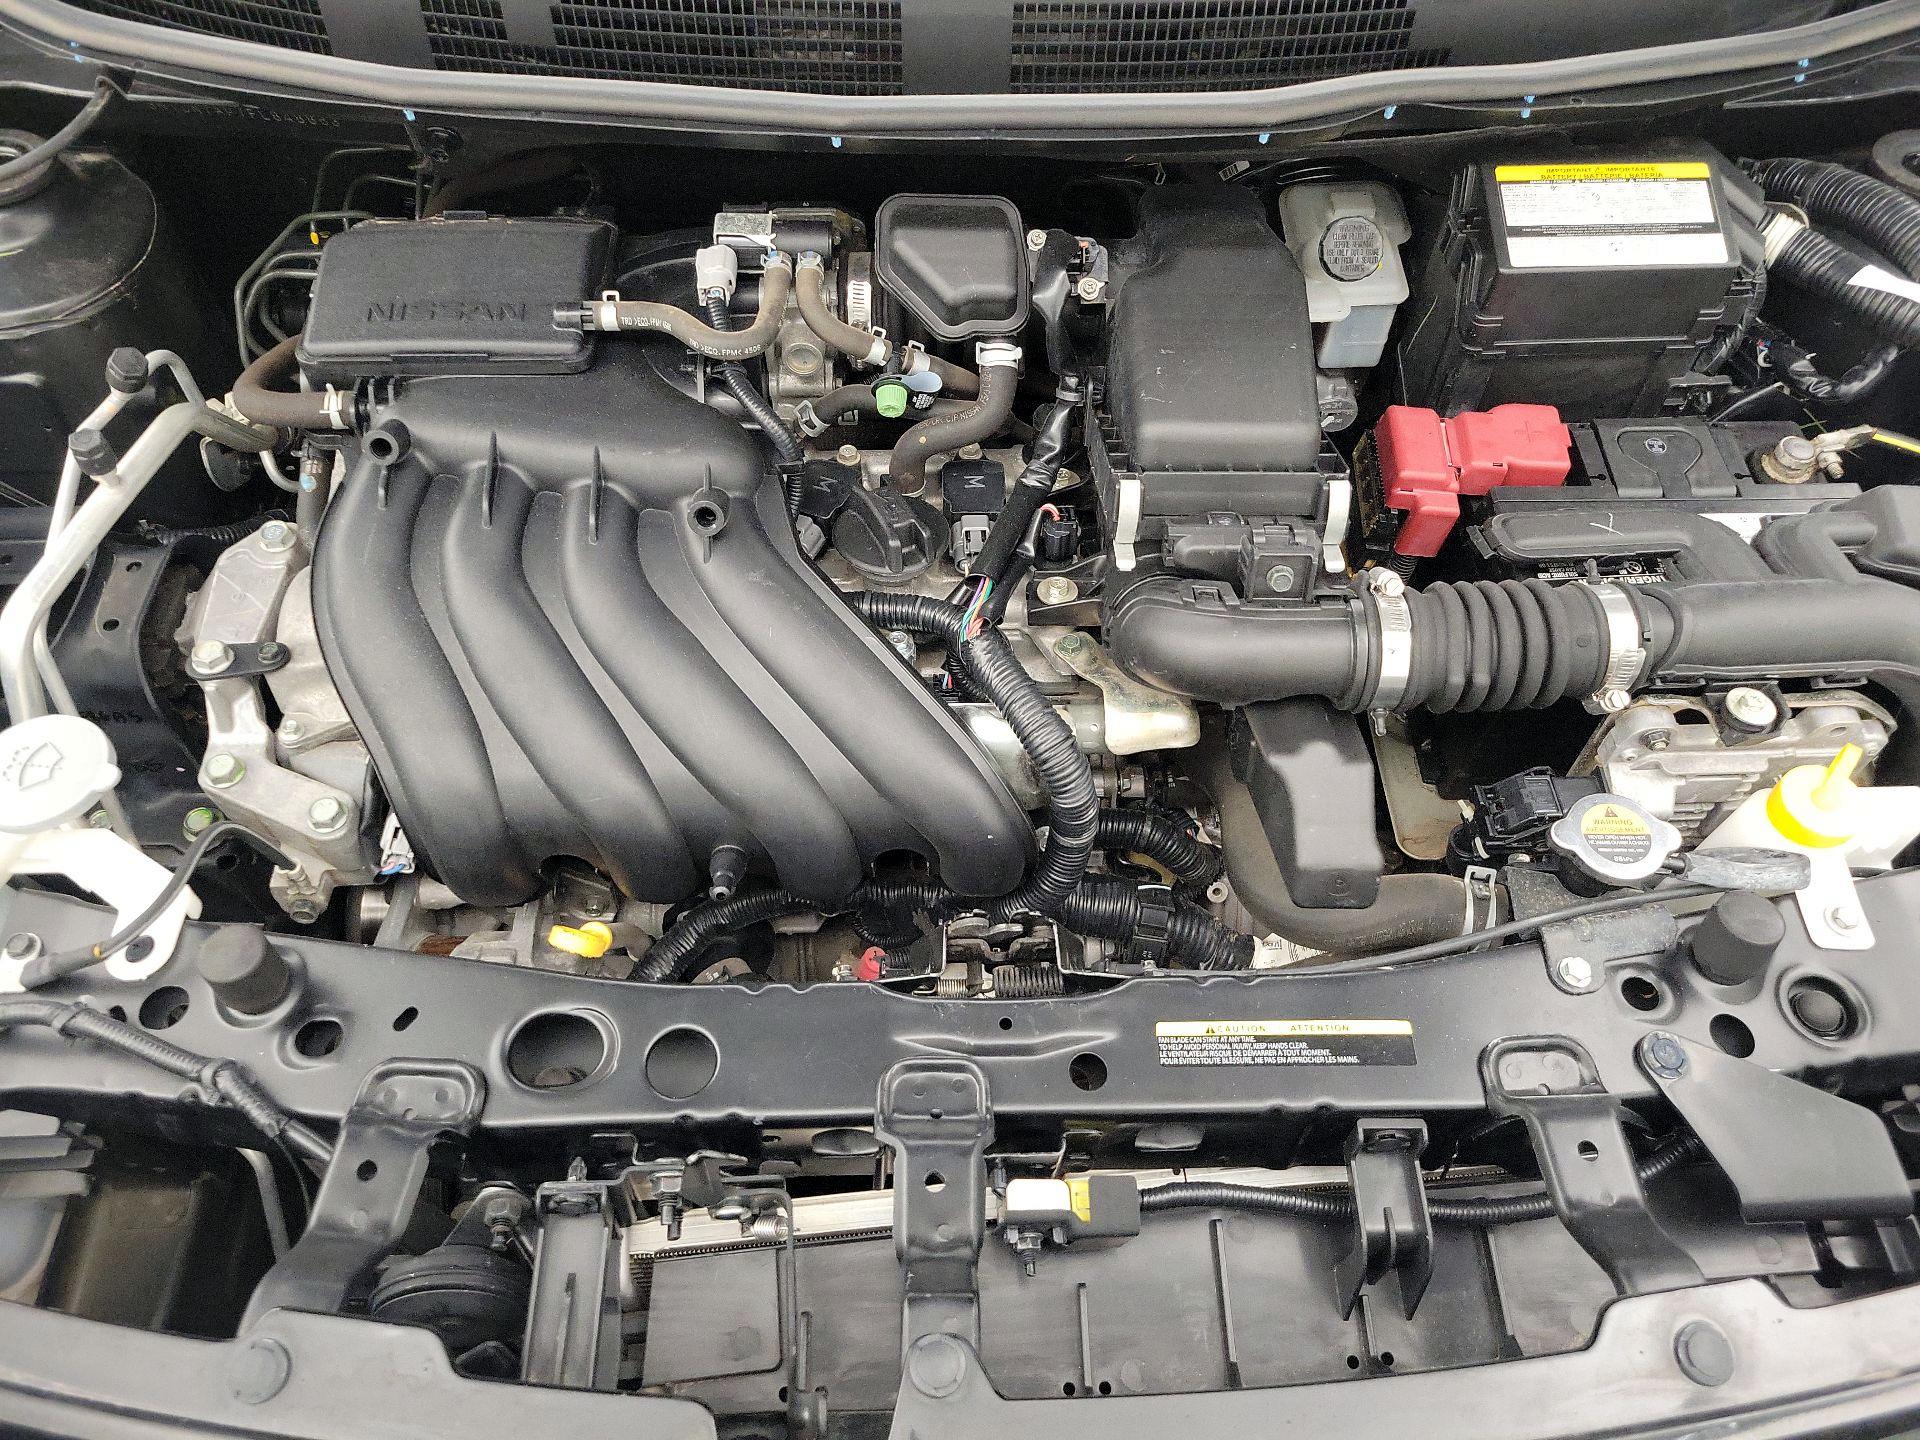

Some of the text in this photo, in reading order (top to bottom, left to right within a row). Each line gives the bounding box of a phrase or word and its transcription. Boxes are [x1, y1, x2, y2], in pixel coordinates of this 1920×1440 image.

[367, 302, 527, 321] NISSAN
[1218, 1024, 1350, 1033] CAUTION ATTENTION
